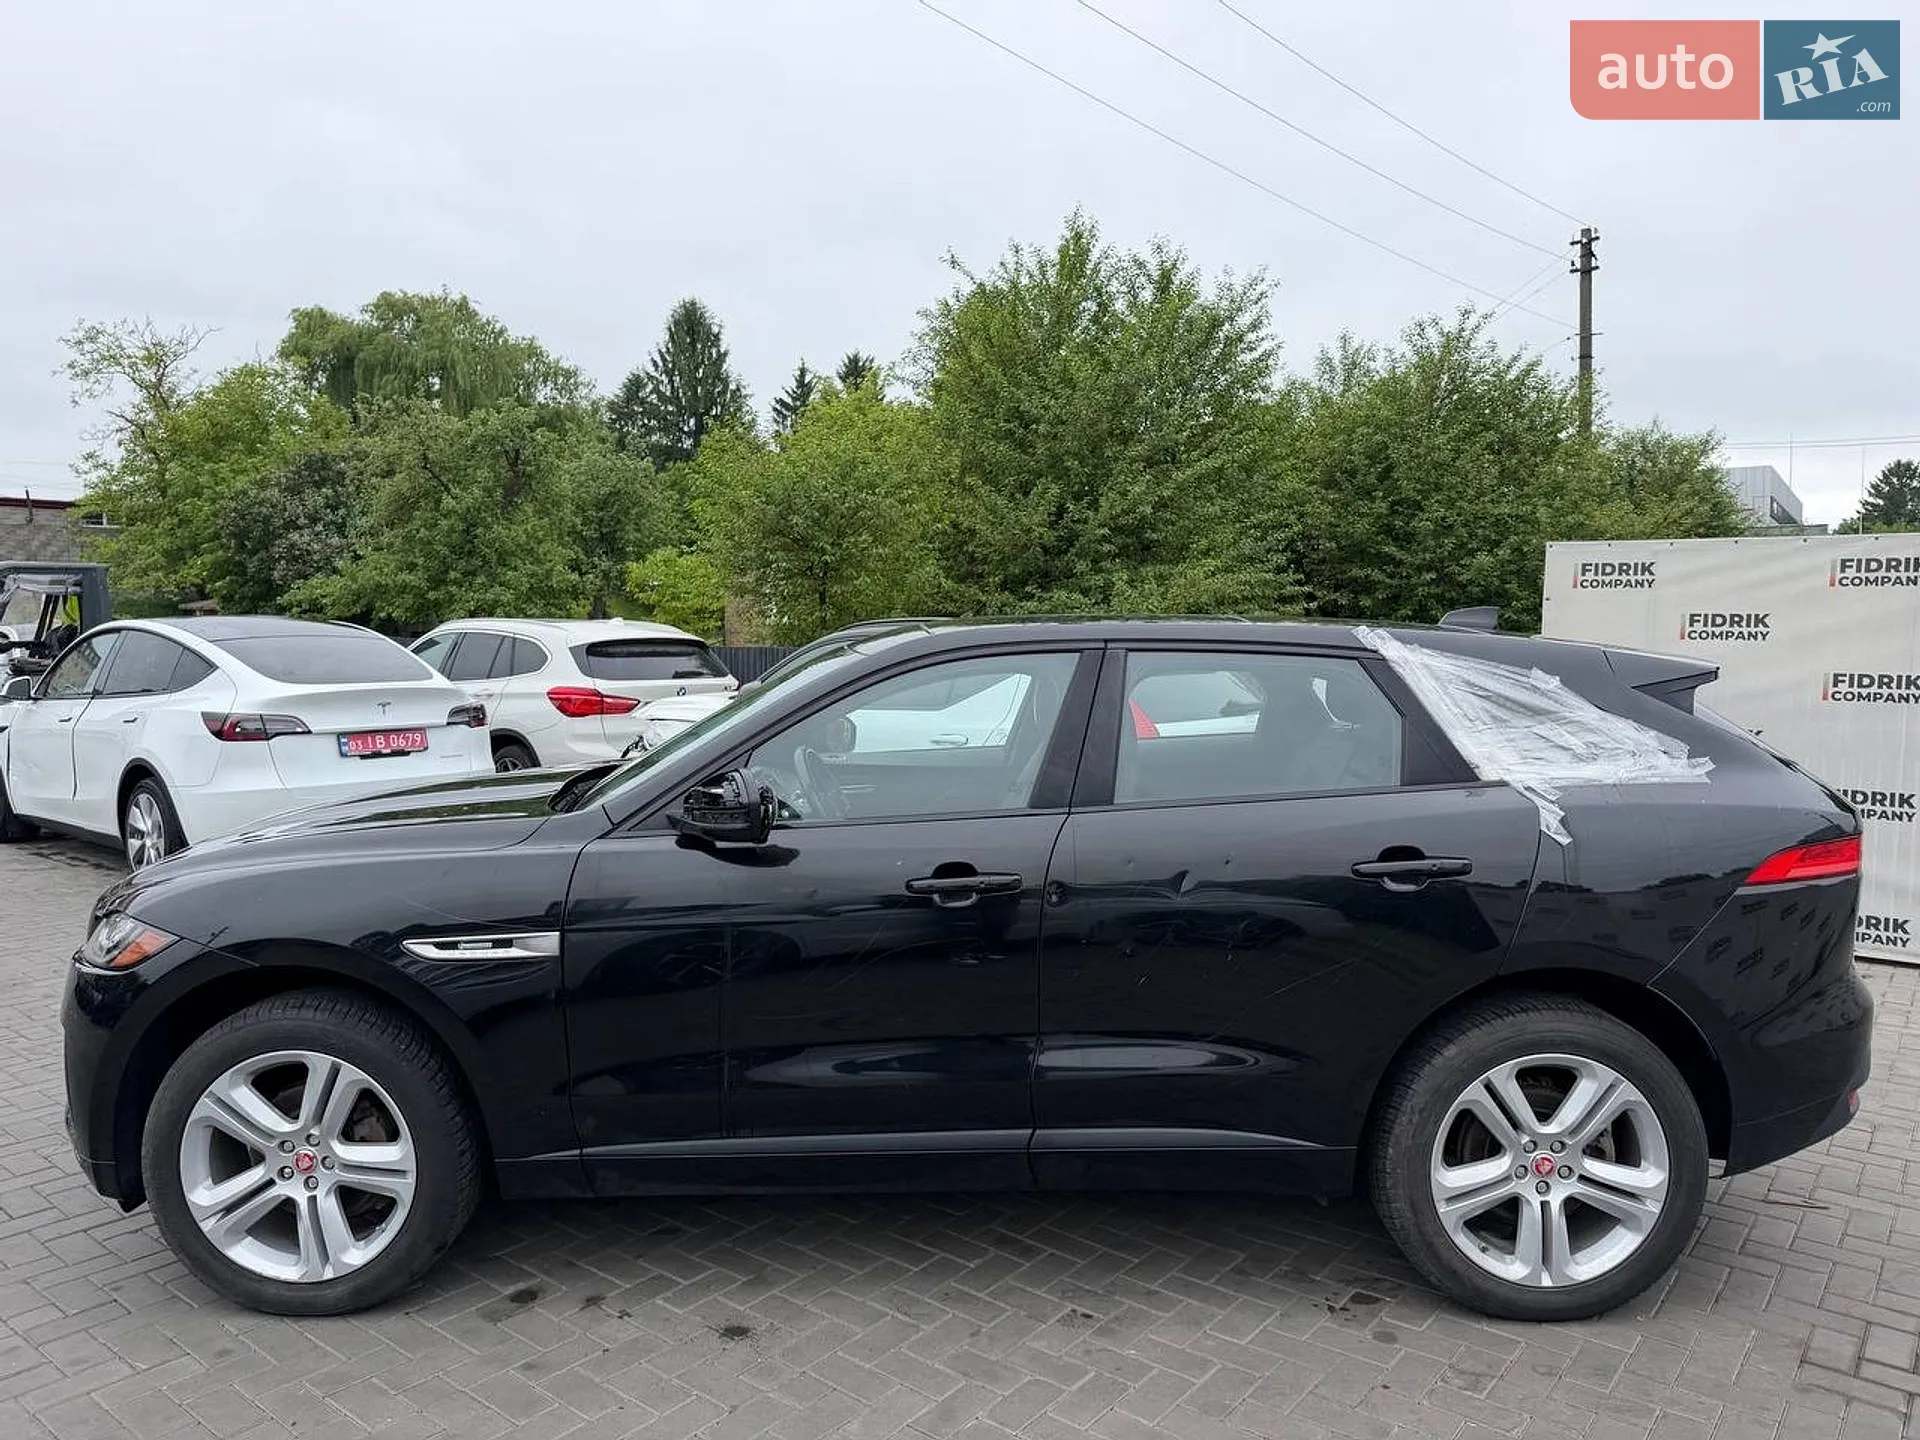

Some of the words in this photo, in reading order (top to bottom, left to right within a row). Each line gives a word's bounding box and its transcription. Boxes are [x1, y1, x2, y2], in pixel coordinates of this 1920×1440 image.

[1581, 562, 1656, 577] FIDRIK
[1580, 578, 1656, 589] COMPANY
[1839, 575, 1920, 587] COMPAN
[1688, 613, 1770, 629] FIDRIK
[1687, 630, 1770, 641] COMPANY
[1832, 673, 1920, 691] FIDRIK
[1831, 691, 1920, 704] COMPANY
[349, 741, 363, 750] 03
[389, 733, 422, 747] 0679
[1838, 789, 1916, 809] DRIK
[1860, 808, 1917, 823] PANY
[1855, 932, 1911, 947] PANY
